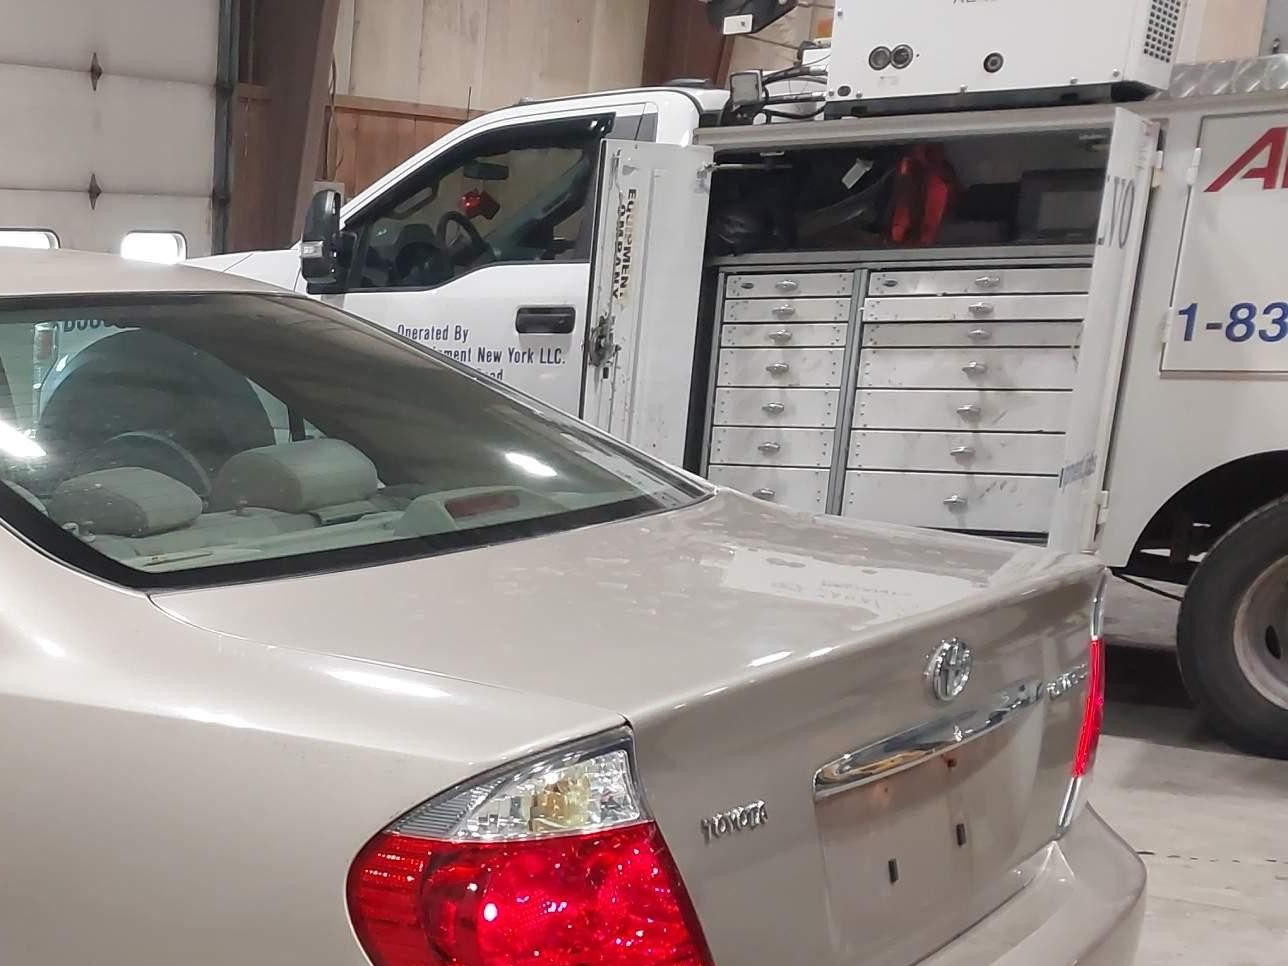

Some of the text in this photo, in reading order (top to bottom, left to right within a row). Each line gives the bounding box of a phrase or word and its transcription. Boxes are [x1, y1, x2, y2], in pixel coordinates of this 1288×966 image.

[1203, 126, 1288, 193] A
[454, 325, 469, 343] By
[477, 348, 502, 363] New
[508, 348, 534, 364] York
[539, 348, 566, 365] LLC.
